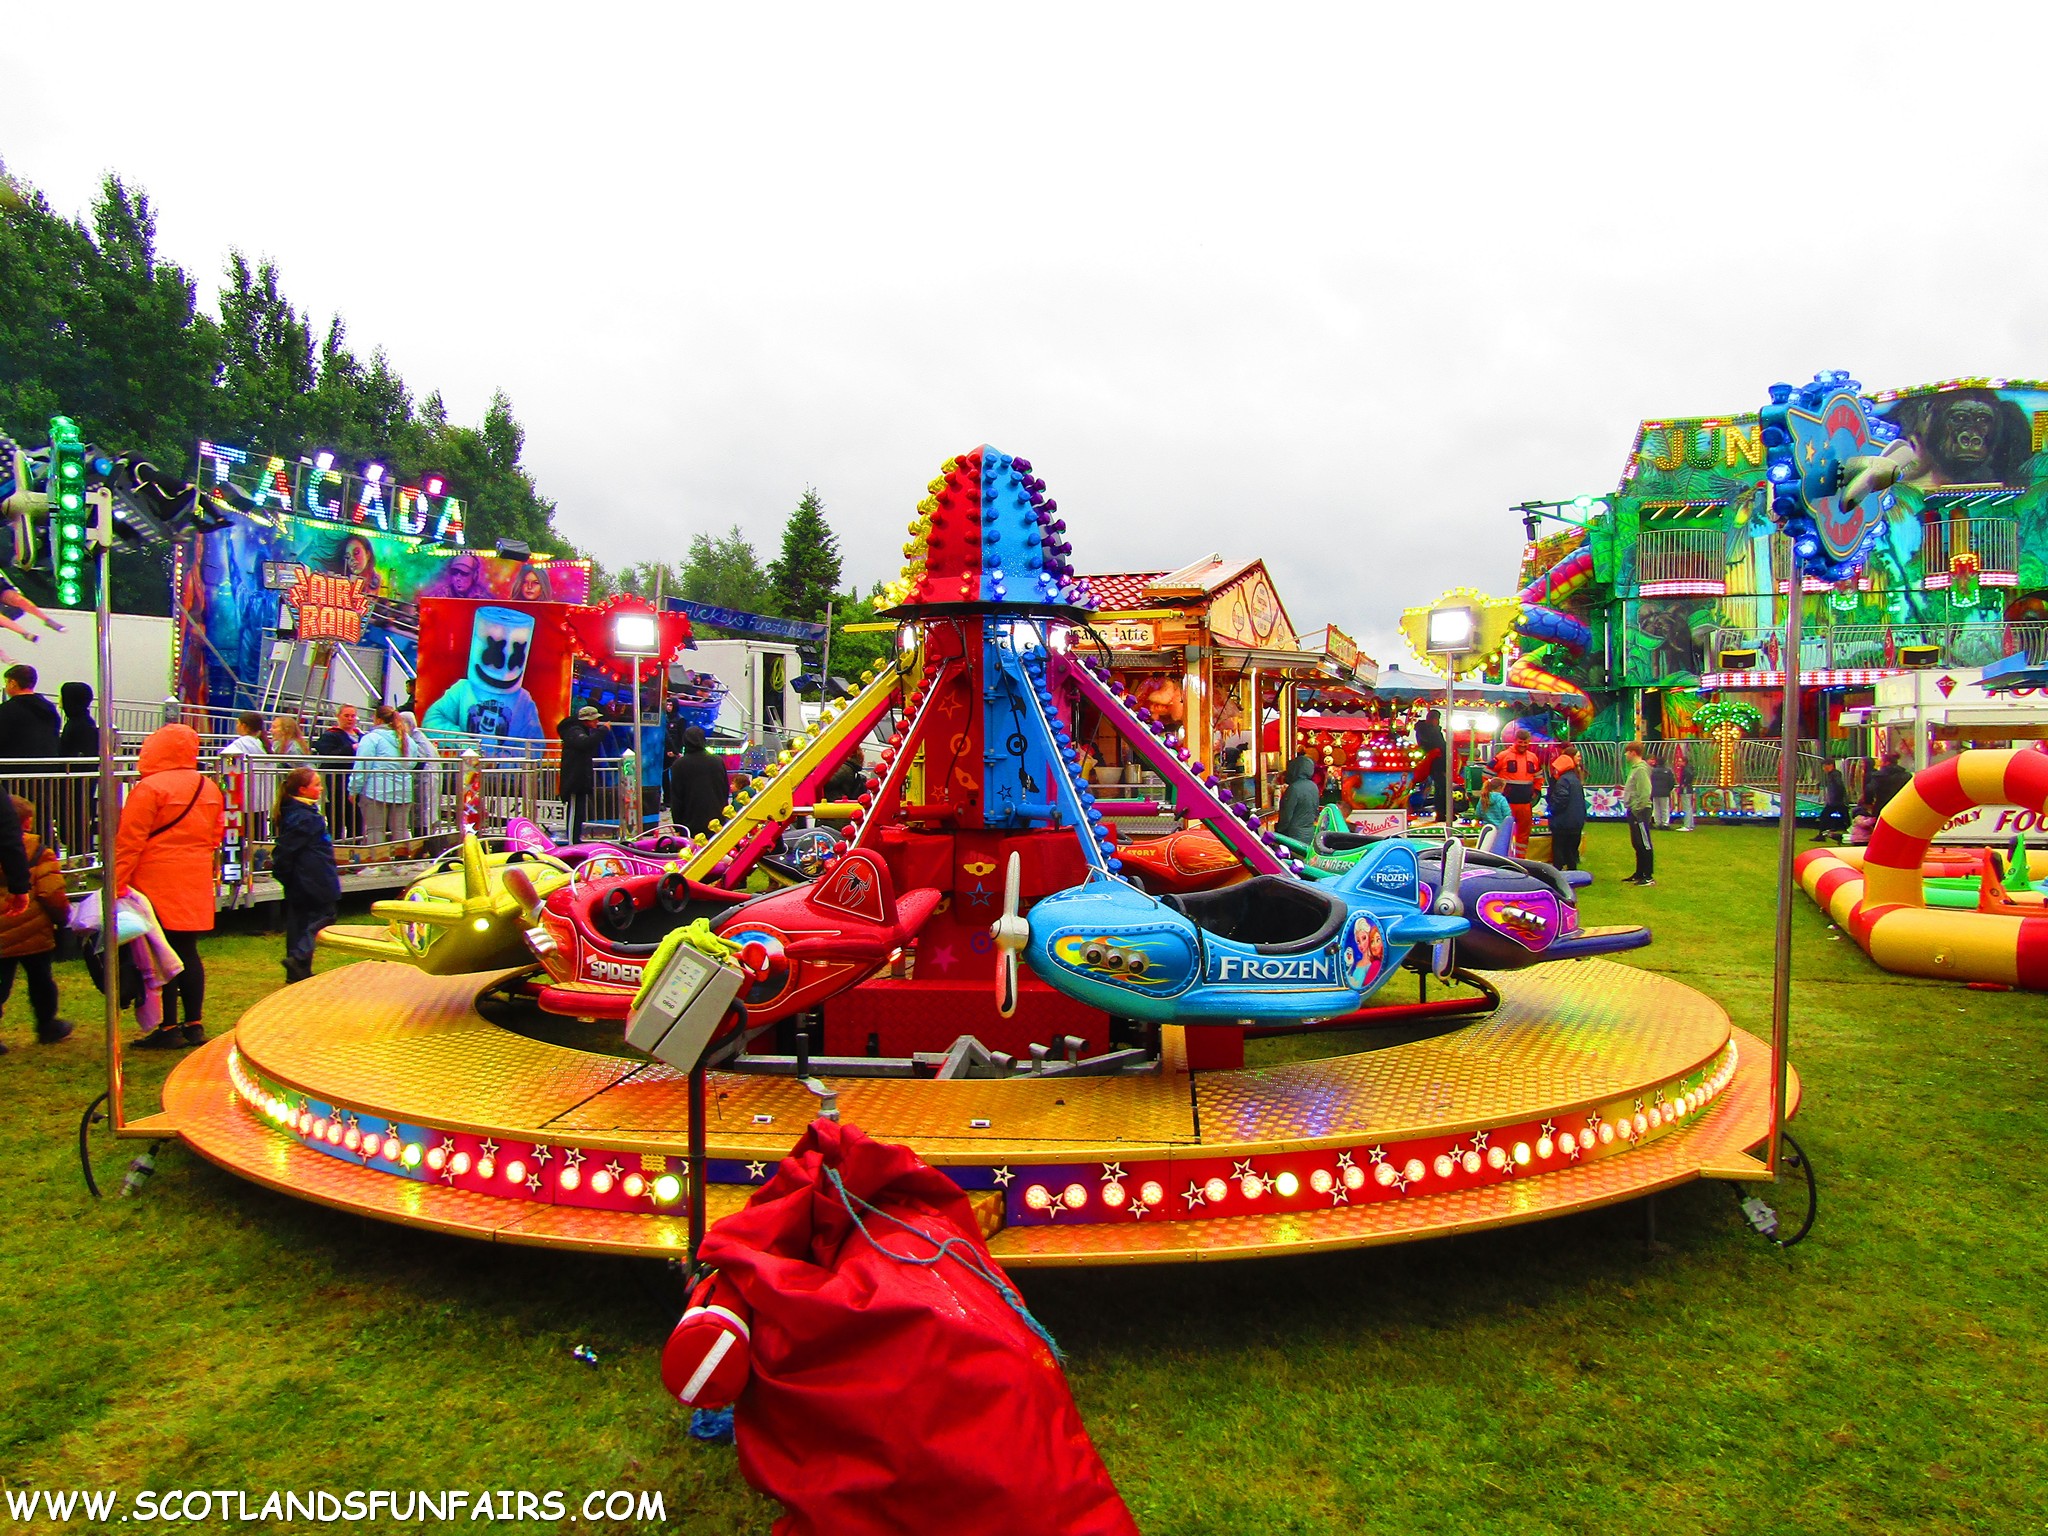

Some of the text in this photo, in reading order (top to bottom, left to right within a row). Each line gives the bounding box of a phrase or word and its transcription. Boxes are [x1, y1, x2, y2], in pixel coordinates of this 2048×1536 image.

[310, 573, 352, 609] AIR
[301, 604, 361, 643] RAID
[1362, 818, 1392, 835] Slush
[1942, 808, 1983, 832] ONLY
[1376, 872, 1409, 883] FROZEN
[590, 960, 643, 983] SPIDER
[1218, 955, 1330, 981] FROZEN
